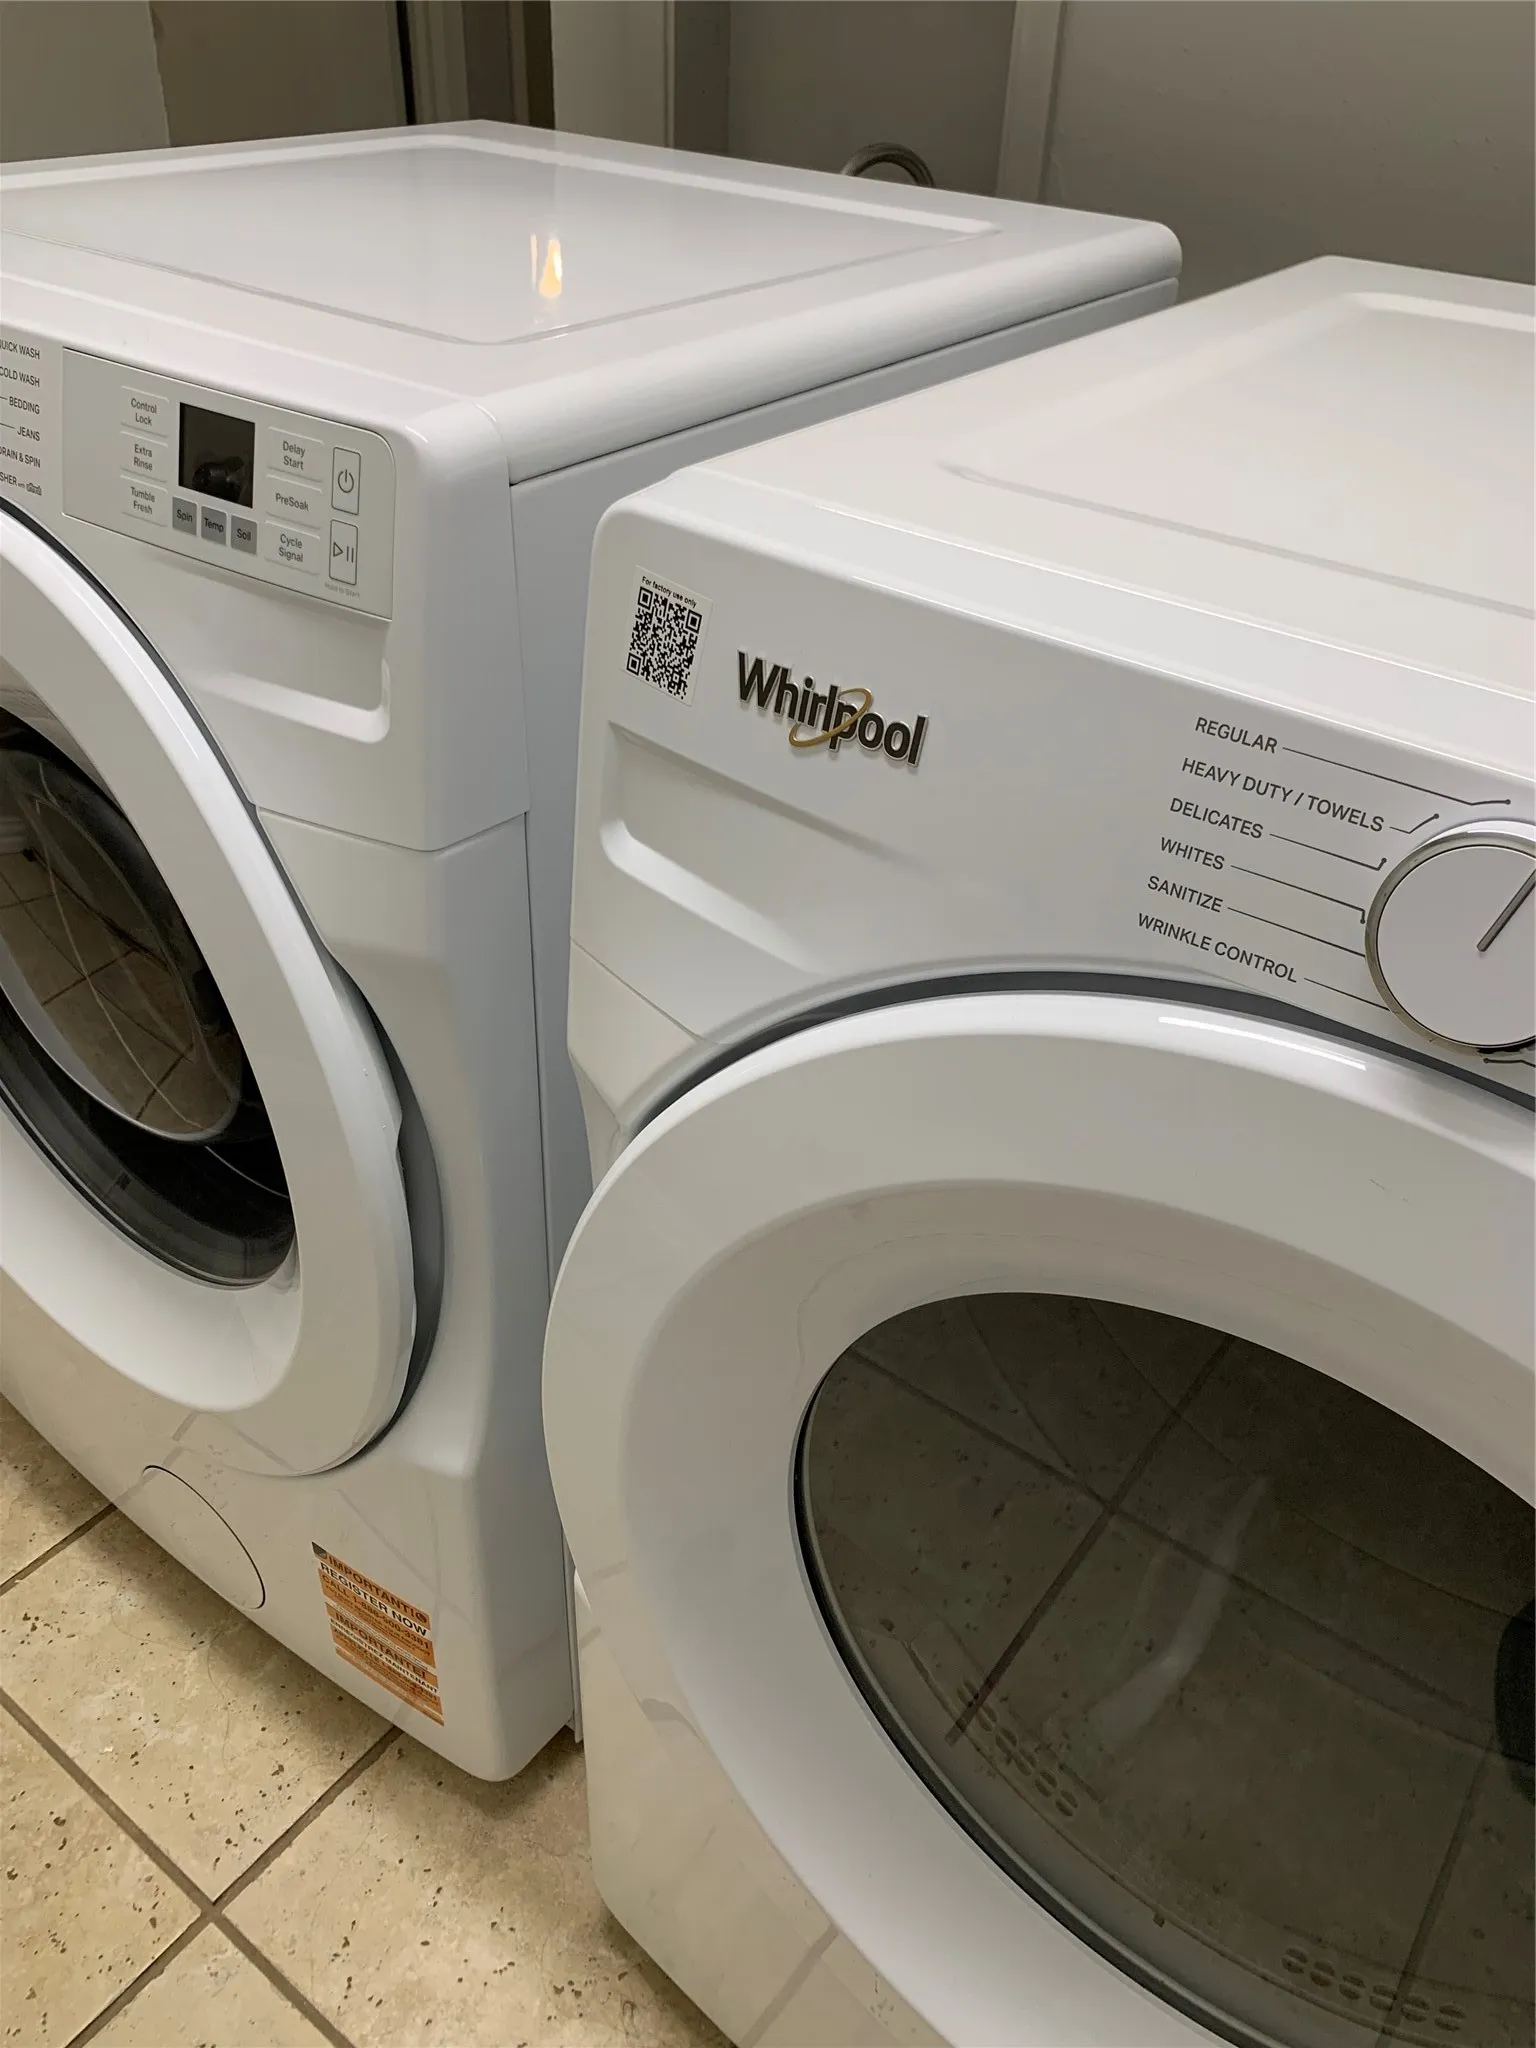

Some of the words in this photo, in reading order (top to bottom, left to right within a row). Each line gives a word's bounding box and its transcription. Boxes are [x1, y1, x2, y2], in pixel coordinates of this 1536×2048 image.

[19, 344, 40, 360] WASH
[19, 372, 40, 388] WASH
[9, 396, 40, 415] BEDDING
[130, 398, 157, 414] Control
[135, 412, 152, 426] Lock
[17, 425, 40, 441] JEANS
[134, 443, 152, 458] Extra
[282, 440, 305, 458] Delay
[19, 452, 24, 463] &
[24, 454, 41, 468] SPIN
[133, 456, 153, 471] Rinse
[283, 455, 304, 471] Start
[130, 486, 155, 503] Tumble
[275, 492, 308, 512] PreSoak
[133, 500, 153, 515] Fresh
[176, 509, 192, 523] Spin
[204, 518, 224, 533] Temp
[237, 528, 251, 541] Soil
[280, 533, 303, 549] Cycle
[278, 546, 304, 563] Signal
[642, 575, 652, 587] For
[652, 580, 672, 597] factory
[672, 591, 683, 602] use
[684, 597, 697, 609] only
[737, 648, 929, 767] Whirlpool
[1195, 716, 1278, 754] REGULAR
[1181, 757, 1241, 787] HEAVY
[1242, 775, 1294, 803] DUTY
[1293, 792, 1304, 806] /
[1308, 794, 1385, 832] TOWELS
[1169, 797, 1264, 839] DELICATES
[1161, 836, 1225, 870] WHITES
[1147, 875, 1224, 913] SANITIZE
[1138, 912, 1212, 951] WRINKLE
[1214, 941, 1297, 983] CONTROL
[322, 1574, 350, 1598] CALL
[320, 1561, 388, 1614] REGISTER
[391, 1610, 427, 1637] NOW
